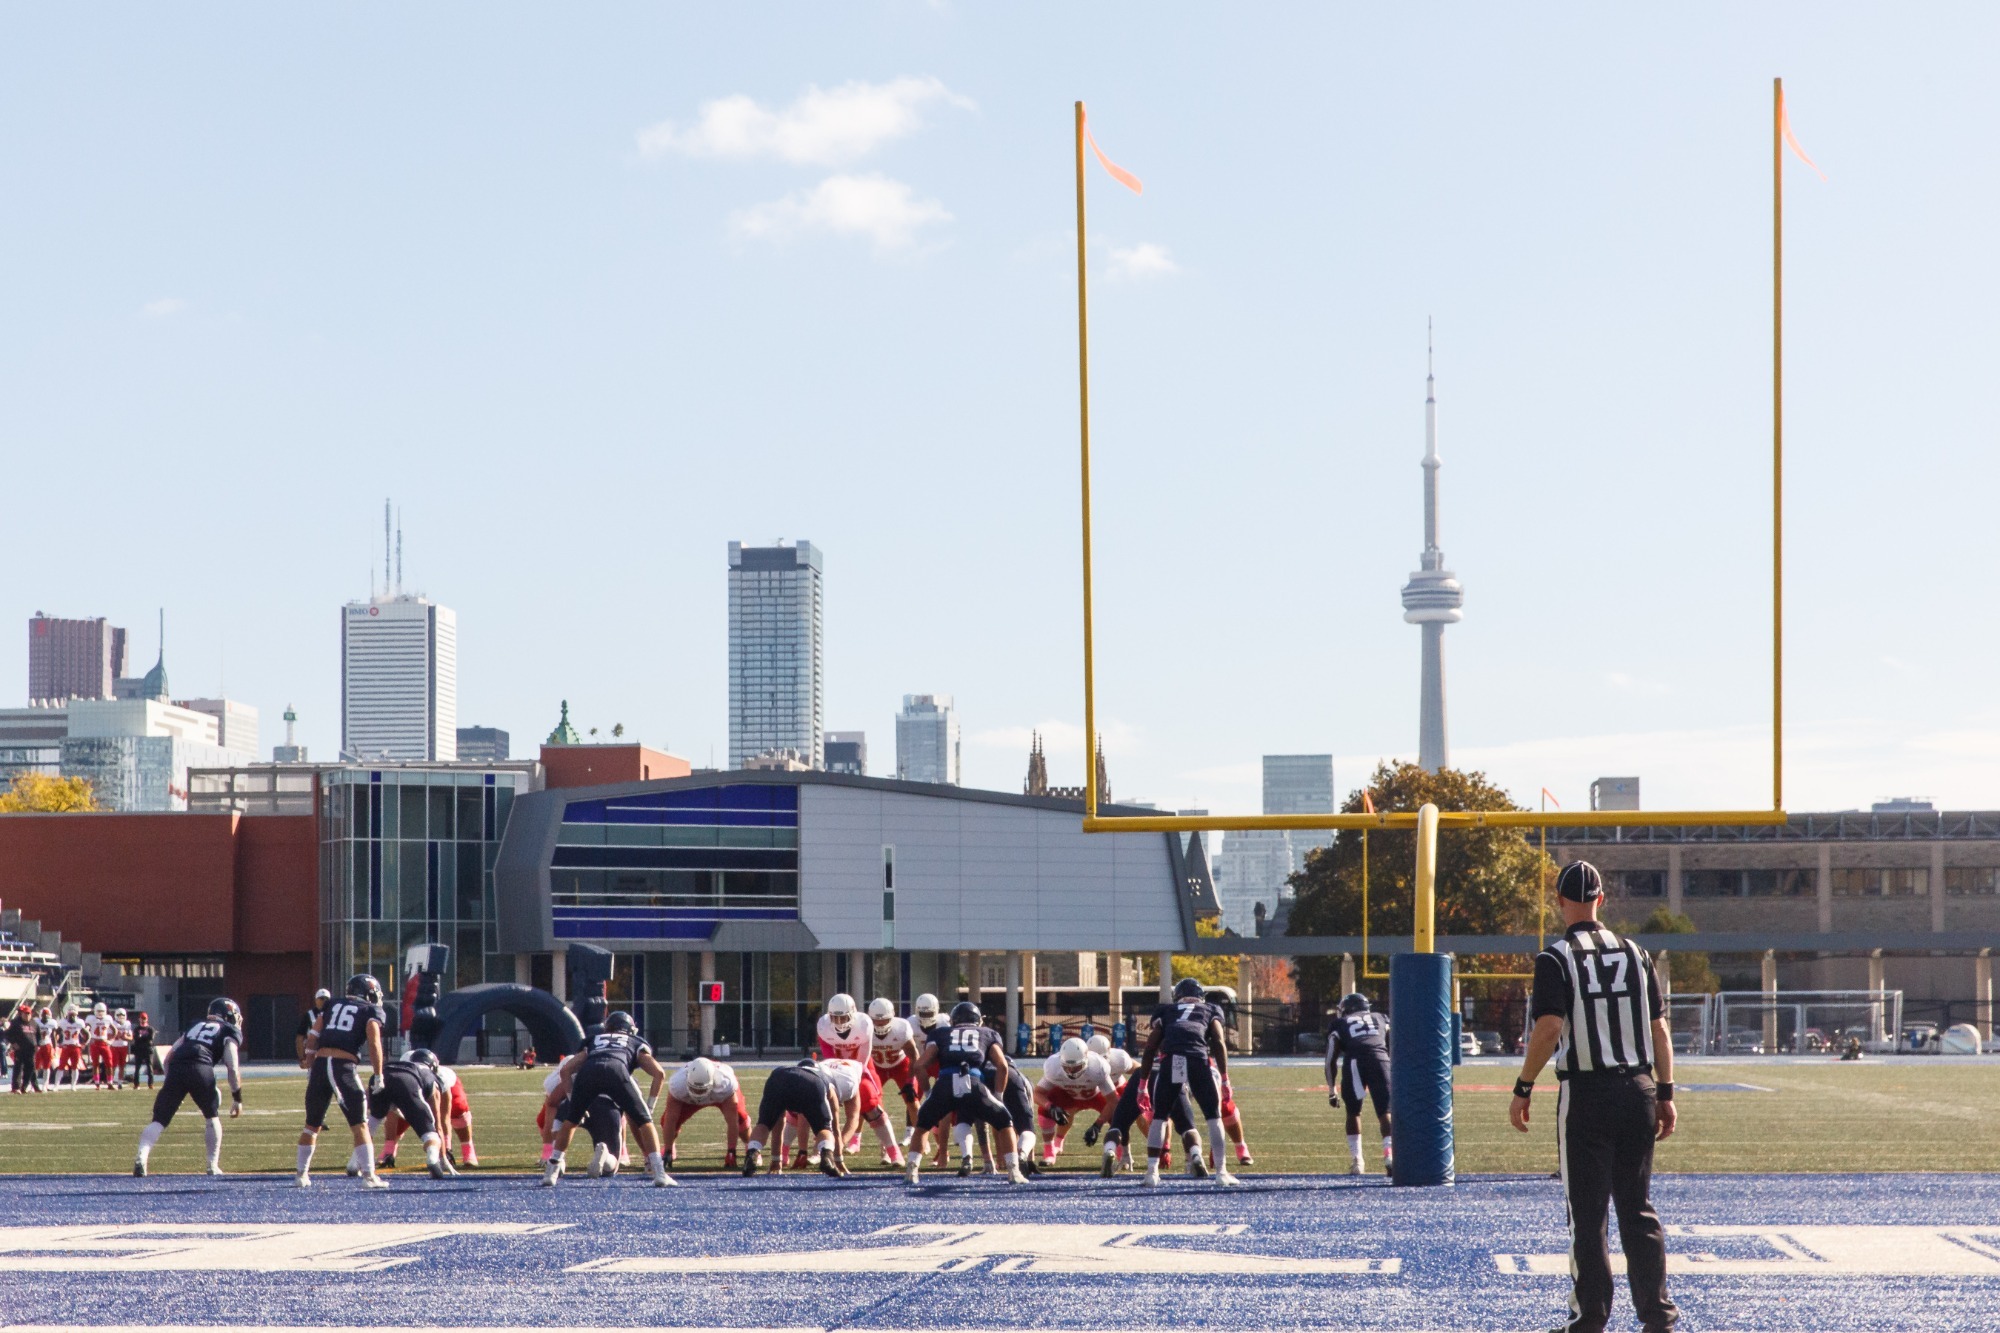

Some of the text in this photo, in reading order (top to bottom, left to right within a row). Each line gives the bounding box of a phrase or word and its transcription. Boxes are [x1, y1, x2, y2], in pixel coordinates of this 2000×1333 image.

[1582, 952, 1628, 993] 17
[325, 1003, 359, 1031] 16
[1176, 1003, 1195, 1022] 7
[186, 1021, 221, 1044] 42
[1346, 1014, 1379, 1038] 21
[593, 1033, 629, 1049] 53
[948, 1029, 980, 1052] 10
